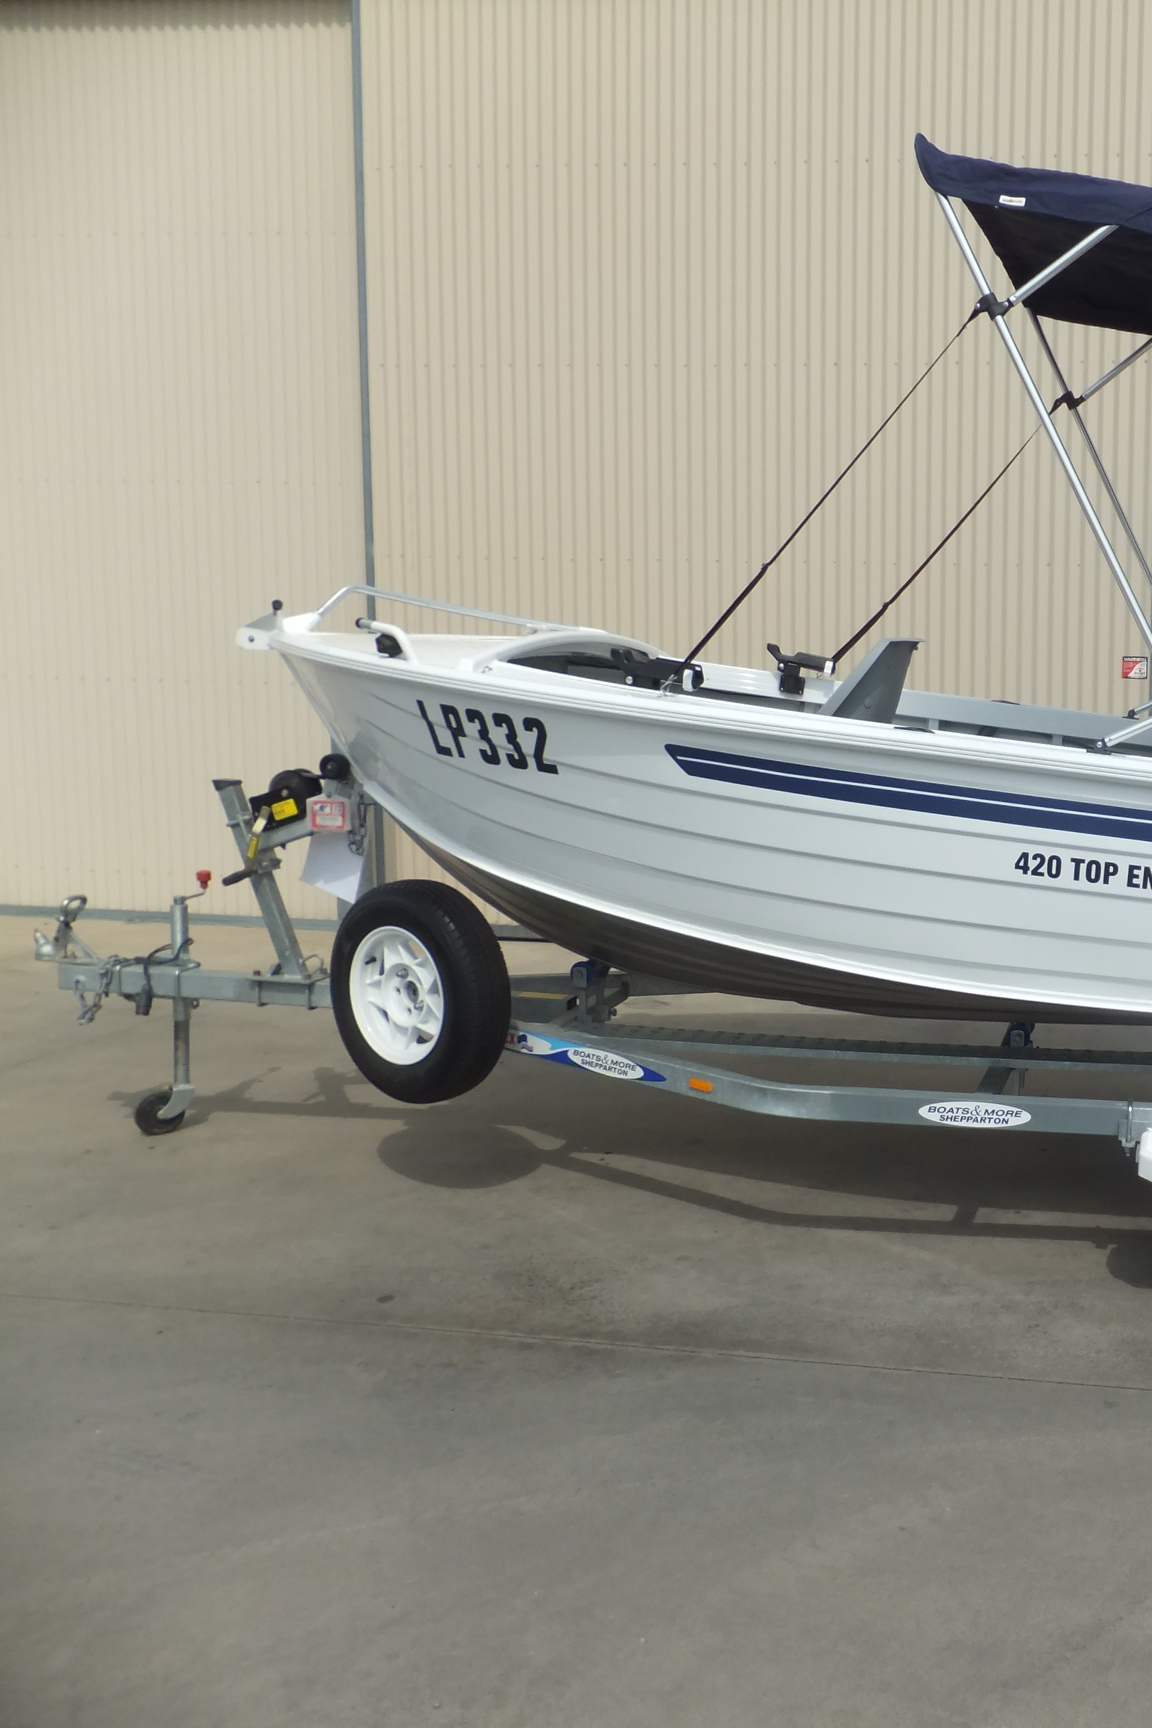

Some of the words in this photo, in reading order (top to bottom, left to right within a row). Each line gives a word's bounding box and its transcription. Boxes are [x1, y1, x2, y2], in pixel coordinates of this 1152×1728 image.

[416, 699, 559, 775] LP332
[1014, 851, 1062, 879] 420
[1070, 857, 1119, 885] TOP
[580, 1058, 629, 1077] SHEPPARTON
[939, 1114, 1010, 1125] SHEPPARTON
